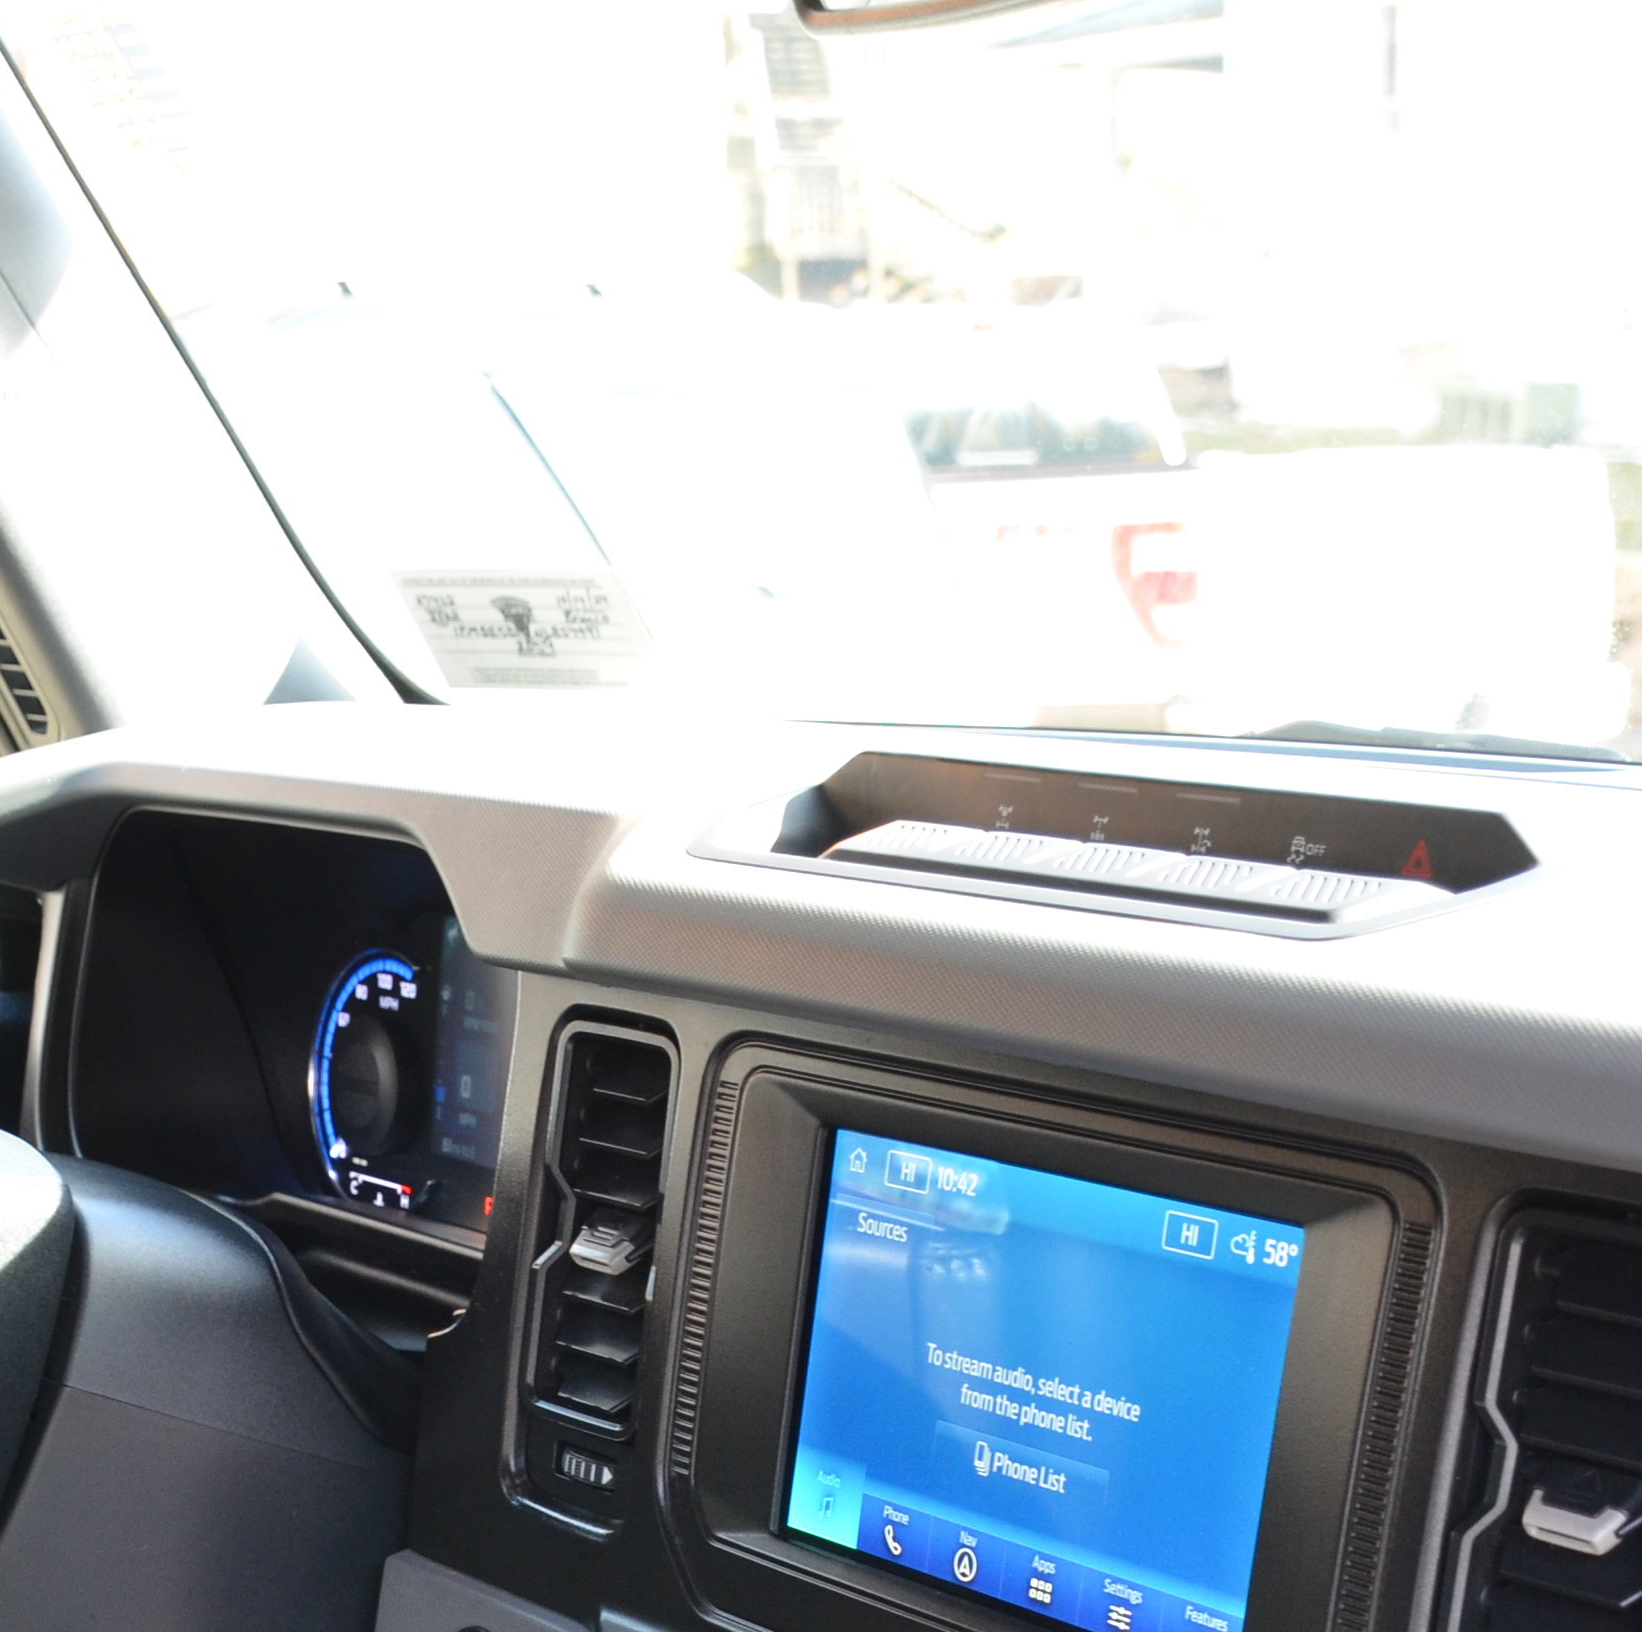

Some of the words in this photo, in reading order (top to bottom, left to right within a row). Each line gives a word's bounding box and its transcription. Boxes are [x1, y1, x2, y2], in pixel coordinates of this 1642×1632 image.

[1306, 843, 1327, 856] OFF
[900, 1162, 917, 1183] HI
[937, 1167, 978, 1197] 10:42
[857, 1212, 907, 1243] Sources
[1180, 1224, 1199, 1246] HI
[1262, 1238, 1299, 1268] 58°
[926, 1342, 944, 1366] To
[944, 1349, 993, 1381] stream
[993, 1362, 1035, 1394] audio,
[1038, 1376, 1080, 1406] select
[1081, 1392, 1092, 1407] a
[1094, 1389, 1141, 1423] device
[960, 1384, 995, 1413] from
[995, 1395, 1019, 1418] the
[1019, 1401, 1065, 1434] phone
[1066, 1413, 1093, 1441] list.
[817, 1469, 841, 1489] Audio
[992, 1451, 1038, 1486] Phone
[1039, 1466, 1067, 1494] List
[883, 1504, 909, 1526] Phone
[960, 1530, 977, 1548] Nav
[1032, 1555, 1056, 1575] Apps
[1104, 1578, 1143, 1605] Settings
[1185, 1605, 1228, 1632] Features
